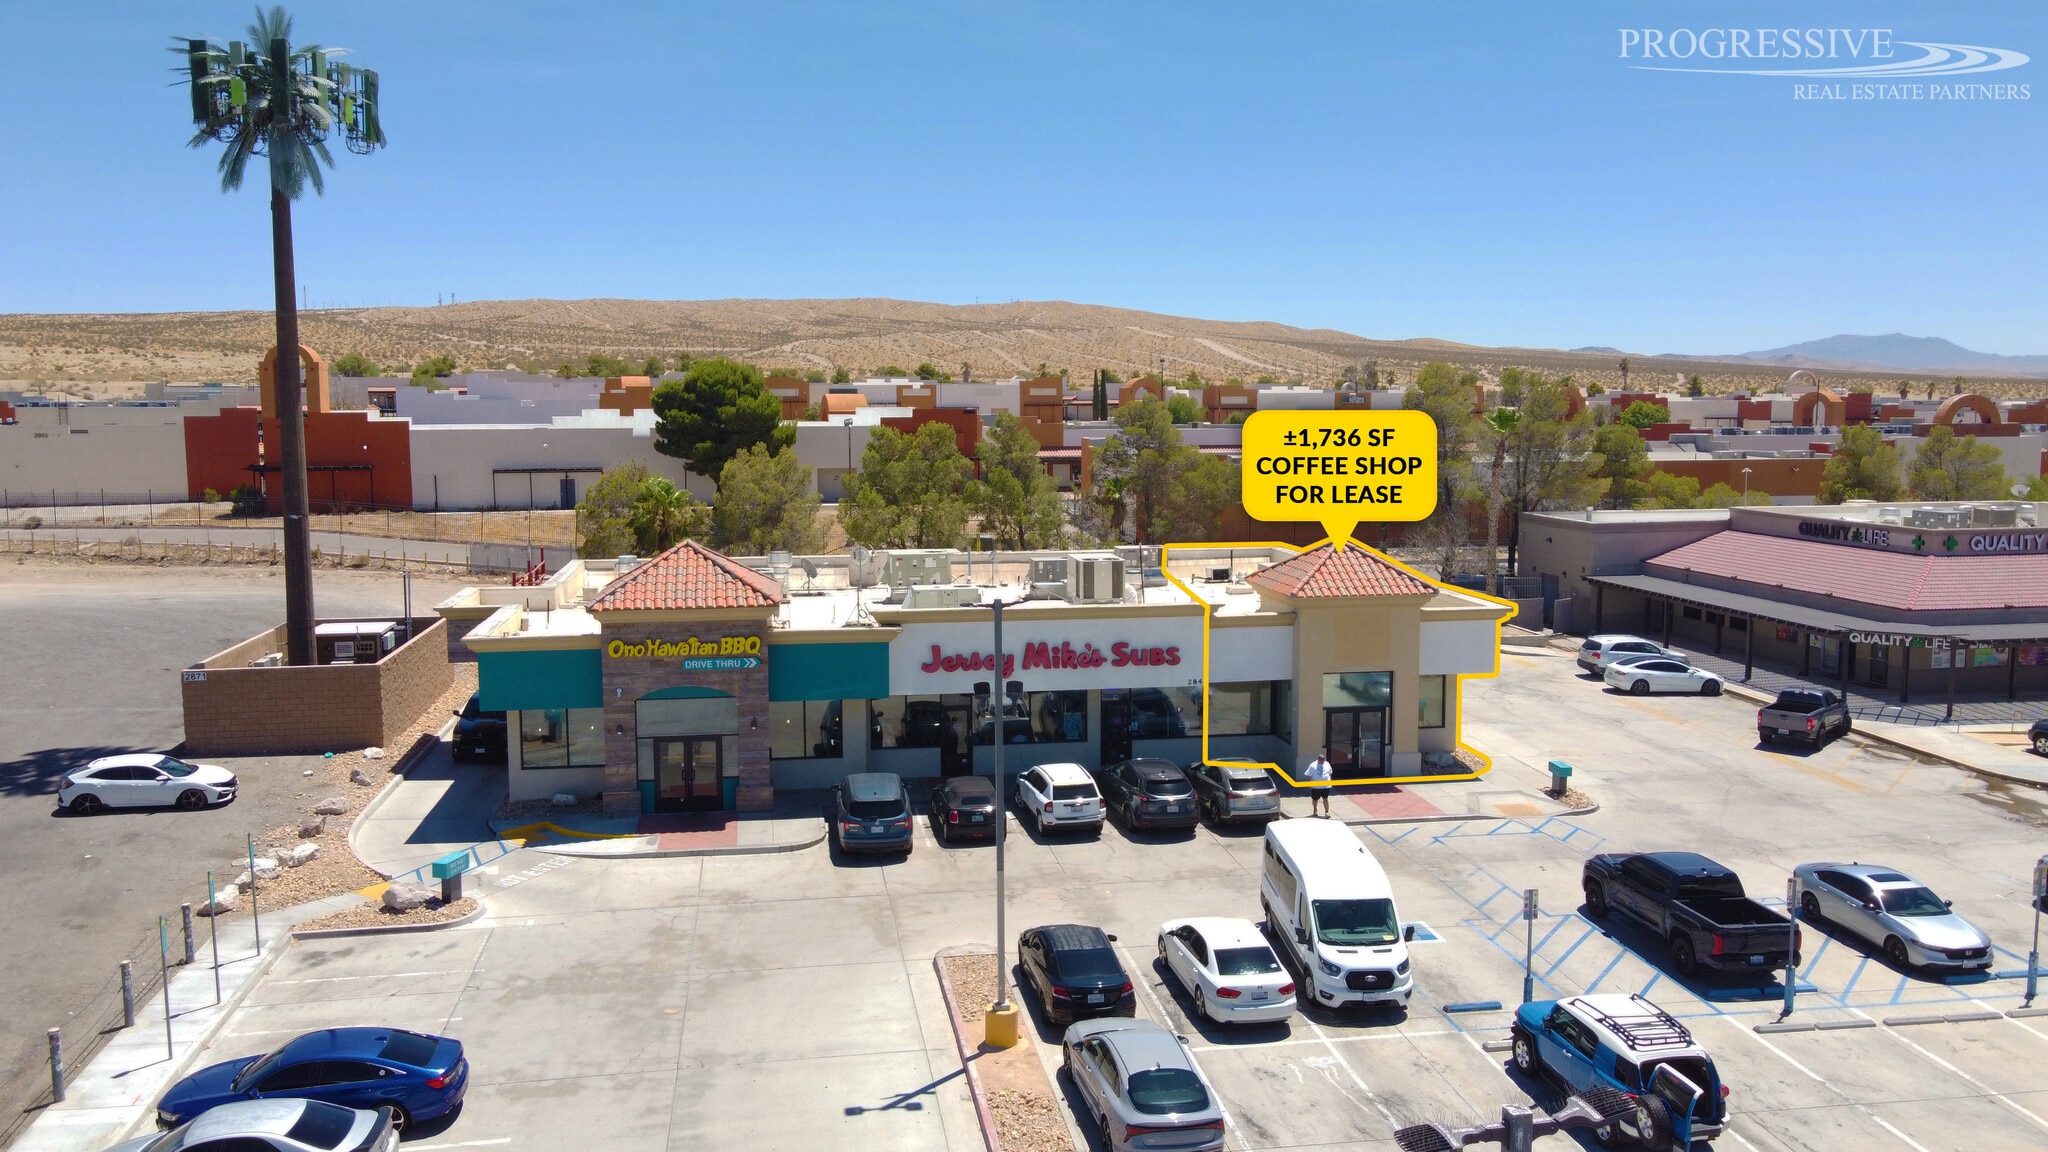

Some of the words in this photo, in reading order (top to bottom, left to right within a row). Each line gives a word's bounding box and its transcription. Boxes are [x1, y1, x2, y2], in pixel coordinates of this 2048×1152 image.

[1798, 521, 1852, 541] QUALITY
[1863, 528, 1890, 547] LIFE
[1970, 534, 2046, 552] QUALITY
[720, 636, 761, 656] BBQ
[1849, 633, 1913, 647] QUALITY
[1925, 638, 1952, 650] LIFE
[685, 660, 713, 669] DRIVE
[715, 660, 741, 668] THRU
[921, 644, 1015, 679] Jersey
[1022, 641, 1108, 670] Mike's
[185, 672, 206, 681] 2871
